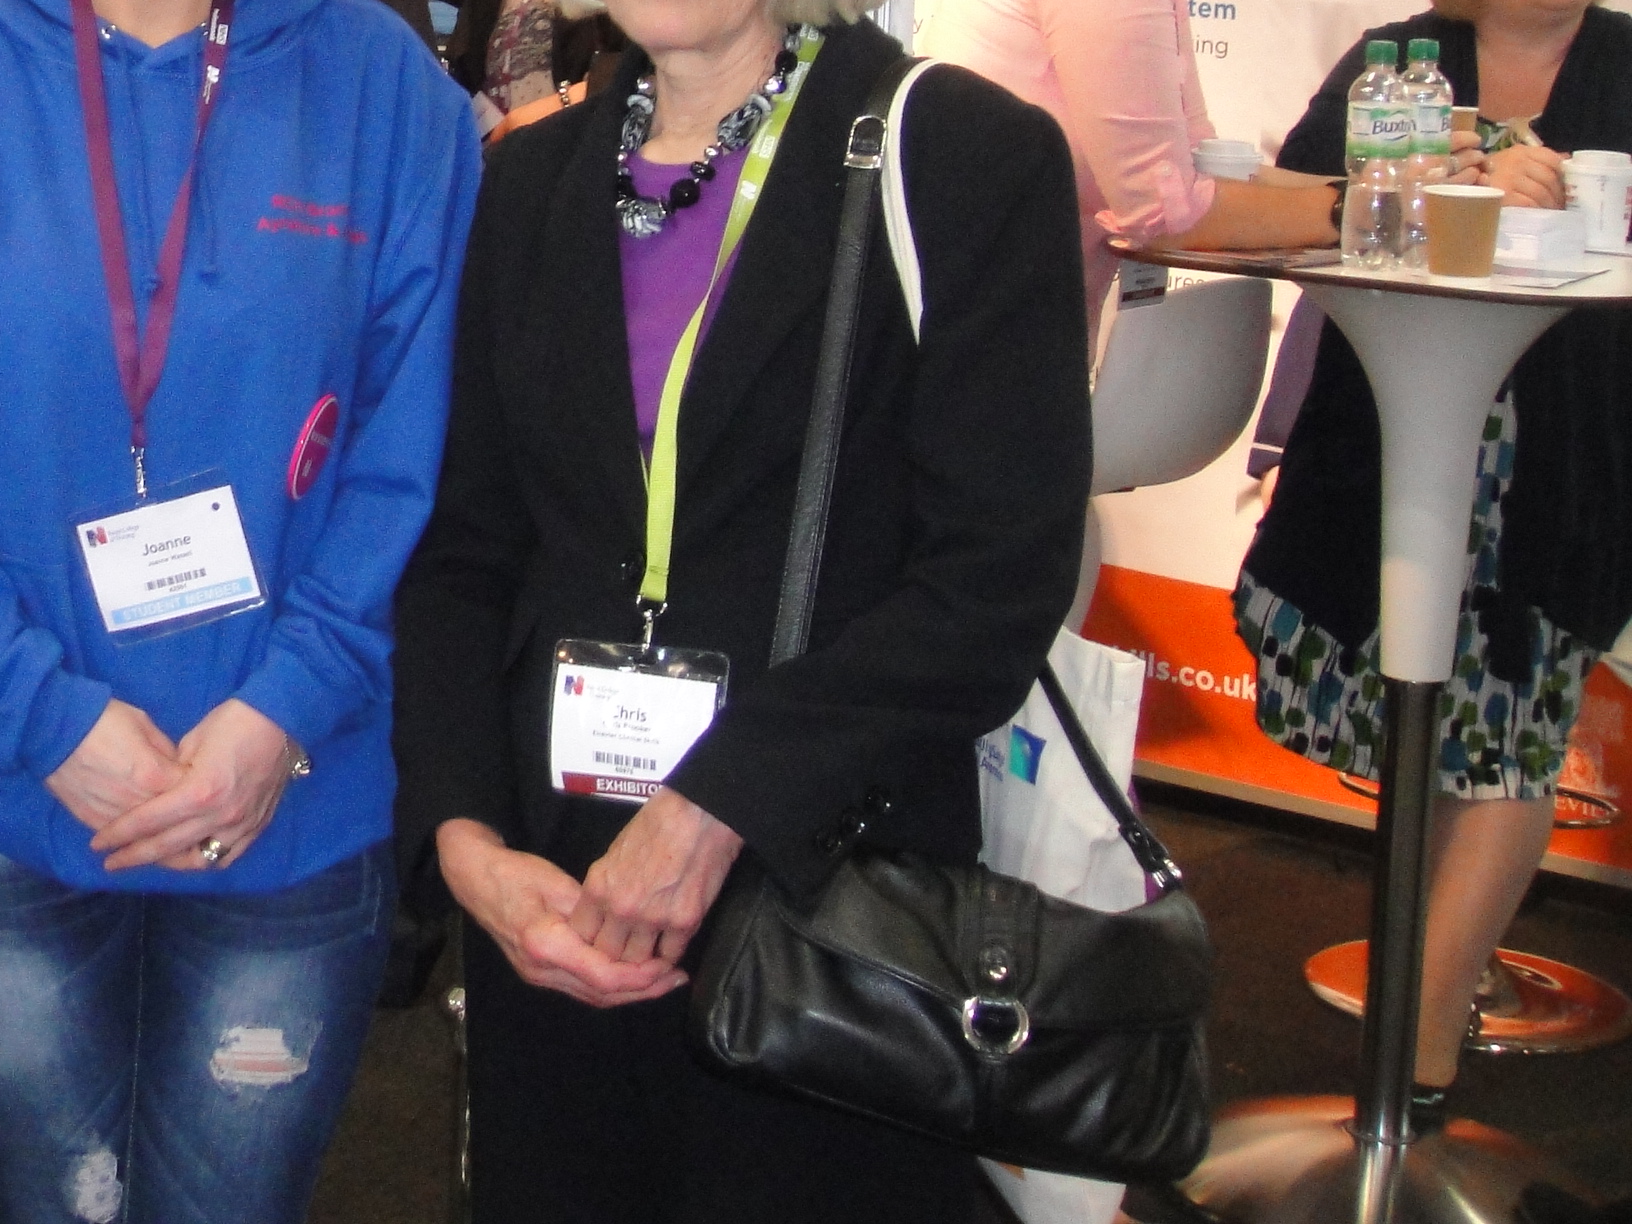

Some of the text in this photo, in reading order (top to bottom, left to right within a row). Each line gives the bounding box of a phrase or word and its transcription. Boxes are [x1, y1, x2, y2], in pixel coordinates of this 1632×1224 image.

[142, 535, 192, 557] Joanne
[1128, 648, 1257, 702] ls.co.uk
[596, 778, 664, 795] EXHIBITO
